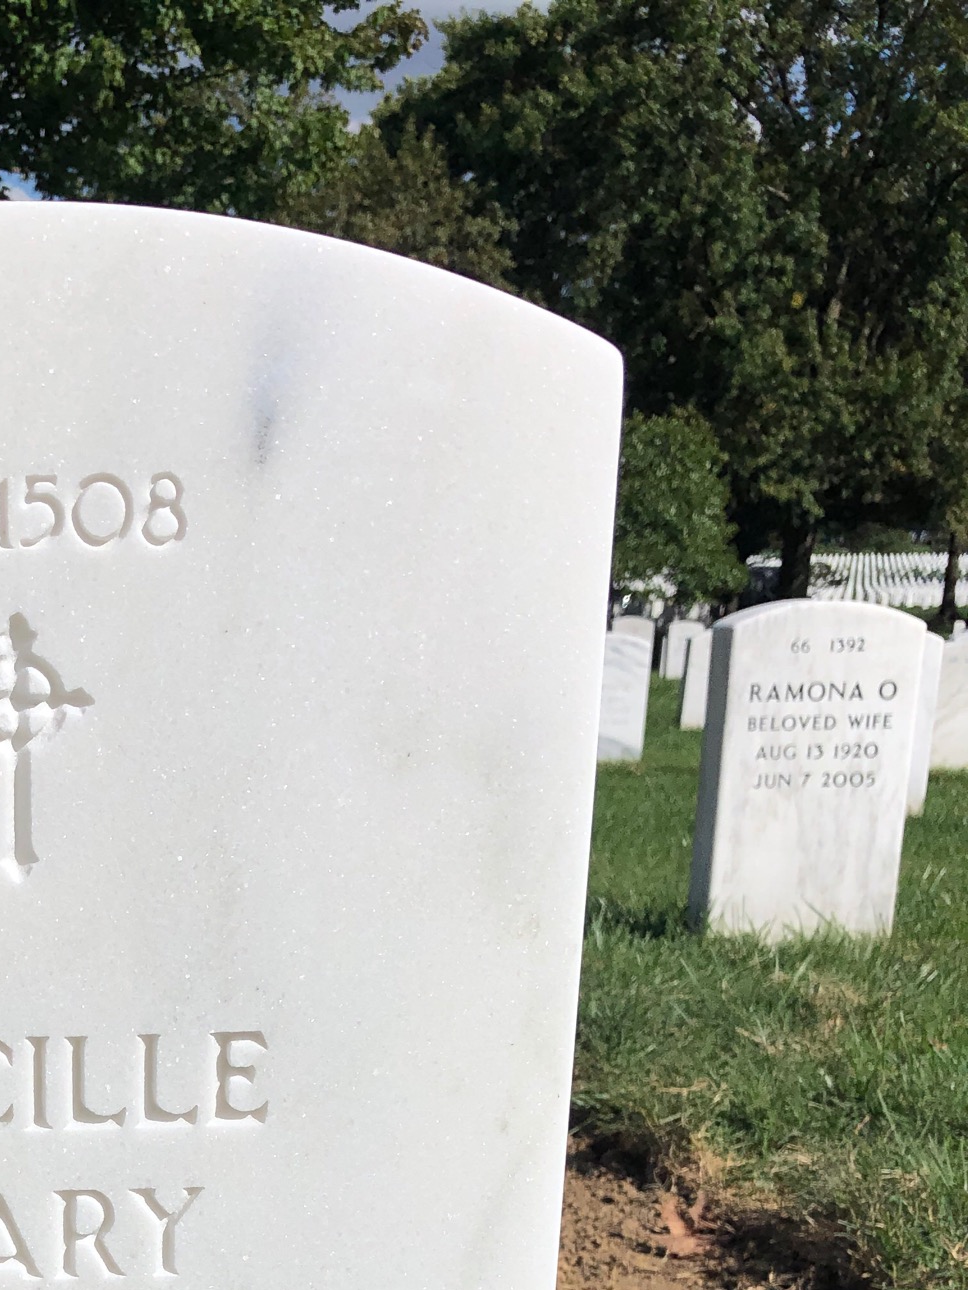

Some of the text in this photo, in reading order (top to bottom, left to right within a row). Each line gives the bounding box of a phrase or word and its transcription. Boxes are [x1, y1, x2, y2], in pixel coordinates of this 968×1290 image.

[791, 637, 865, 653] 66 1392
[749, 679, 897, 702] RAMONA O
[747, 712, 893, 732] BELOVED WIFE
[756, 741, 879, 760] AUG 13 1920
[753, 770, 876, 789] JUN 7 2005
